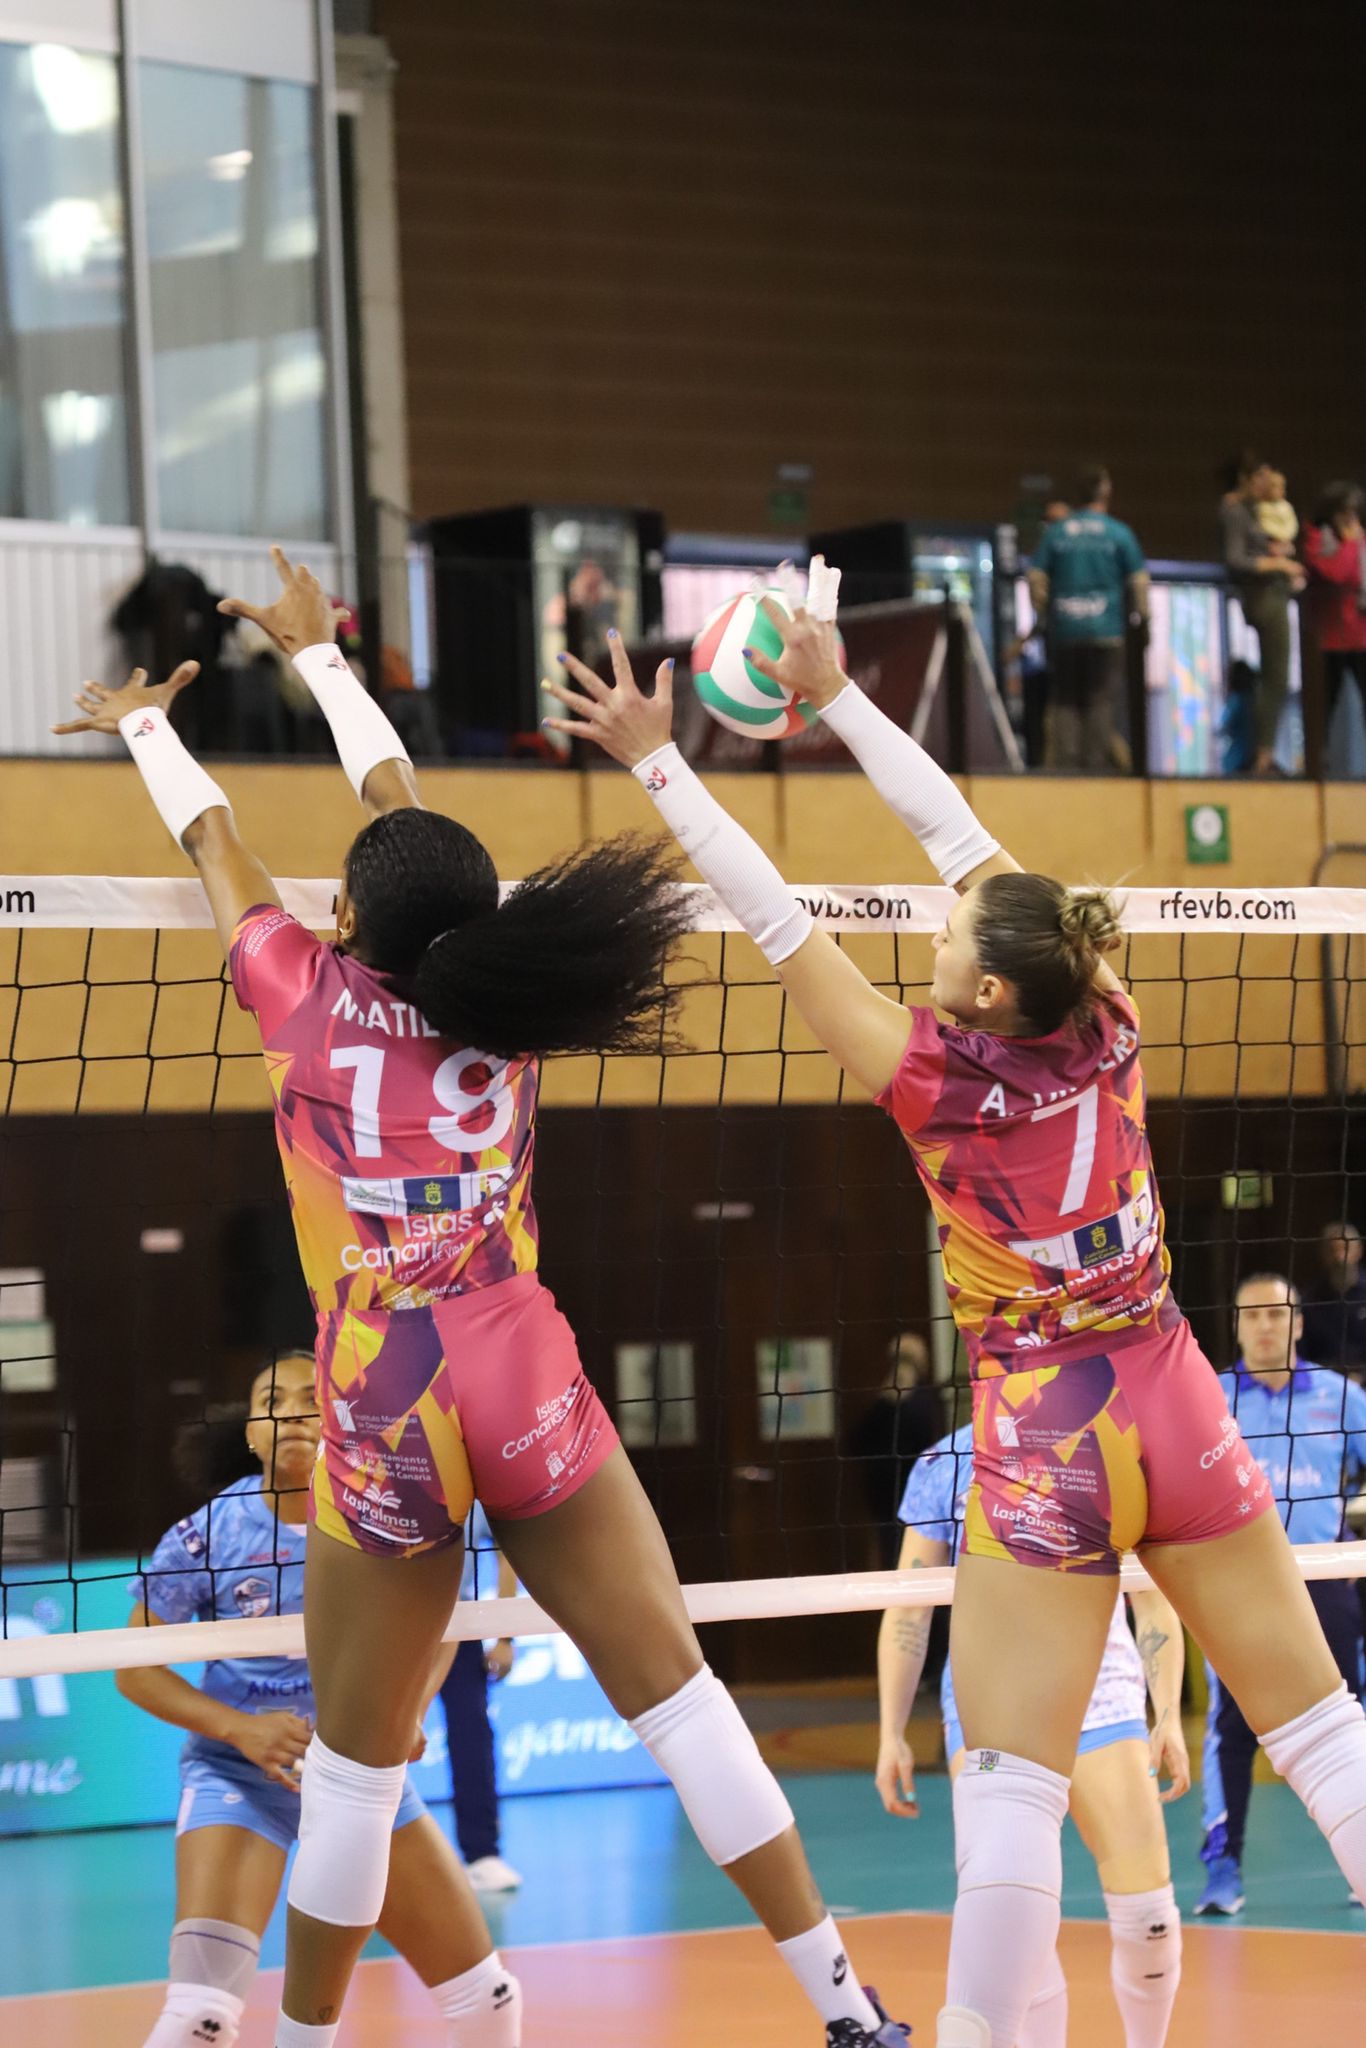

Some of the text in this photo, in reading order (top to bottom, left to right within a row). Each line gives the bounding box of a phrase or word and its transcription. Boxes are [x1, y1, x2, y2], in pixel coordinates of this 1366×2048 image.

[1160, 891, 1296, 920] rfevb.com
[1030, 1083, 1099, 1217] 7
[402, 1212, 474, 1239] Islas
[394, 1462, 430, 1474] Palmas
[396, 1471, 432, 1481] Canaria
[1060, 1474, 1098, 1486] Palmas
[1060, 1482, 1099, 1494] Canaria
[342, 1486, 419, 1529] LasPalmas
